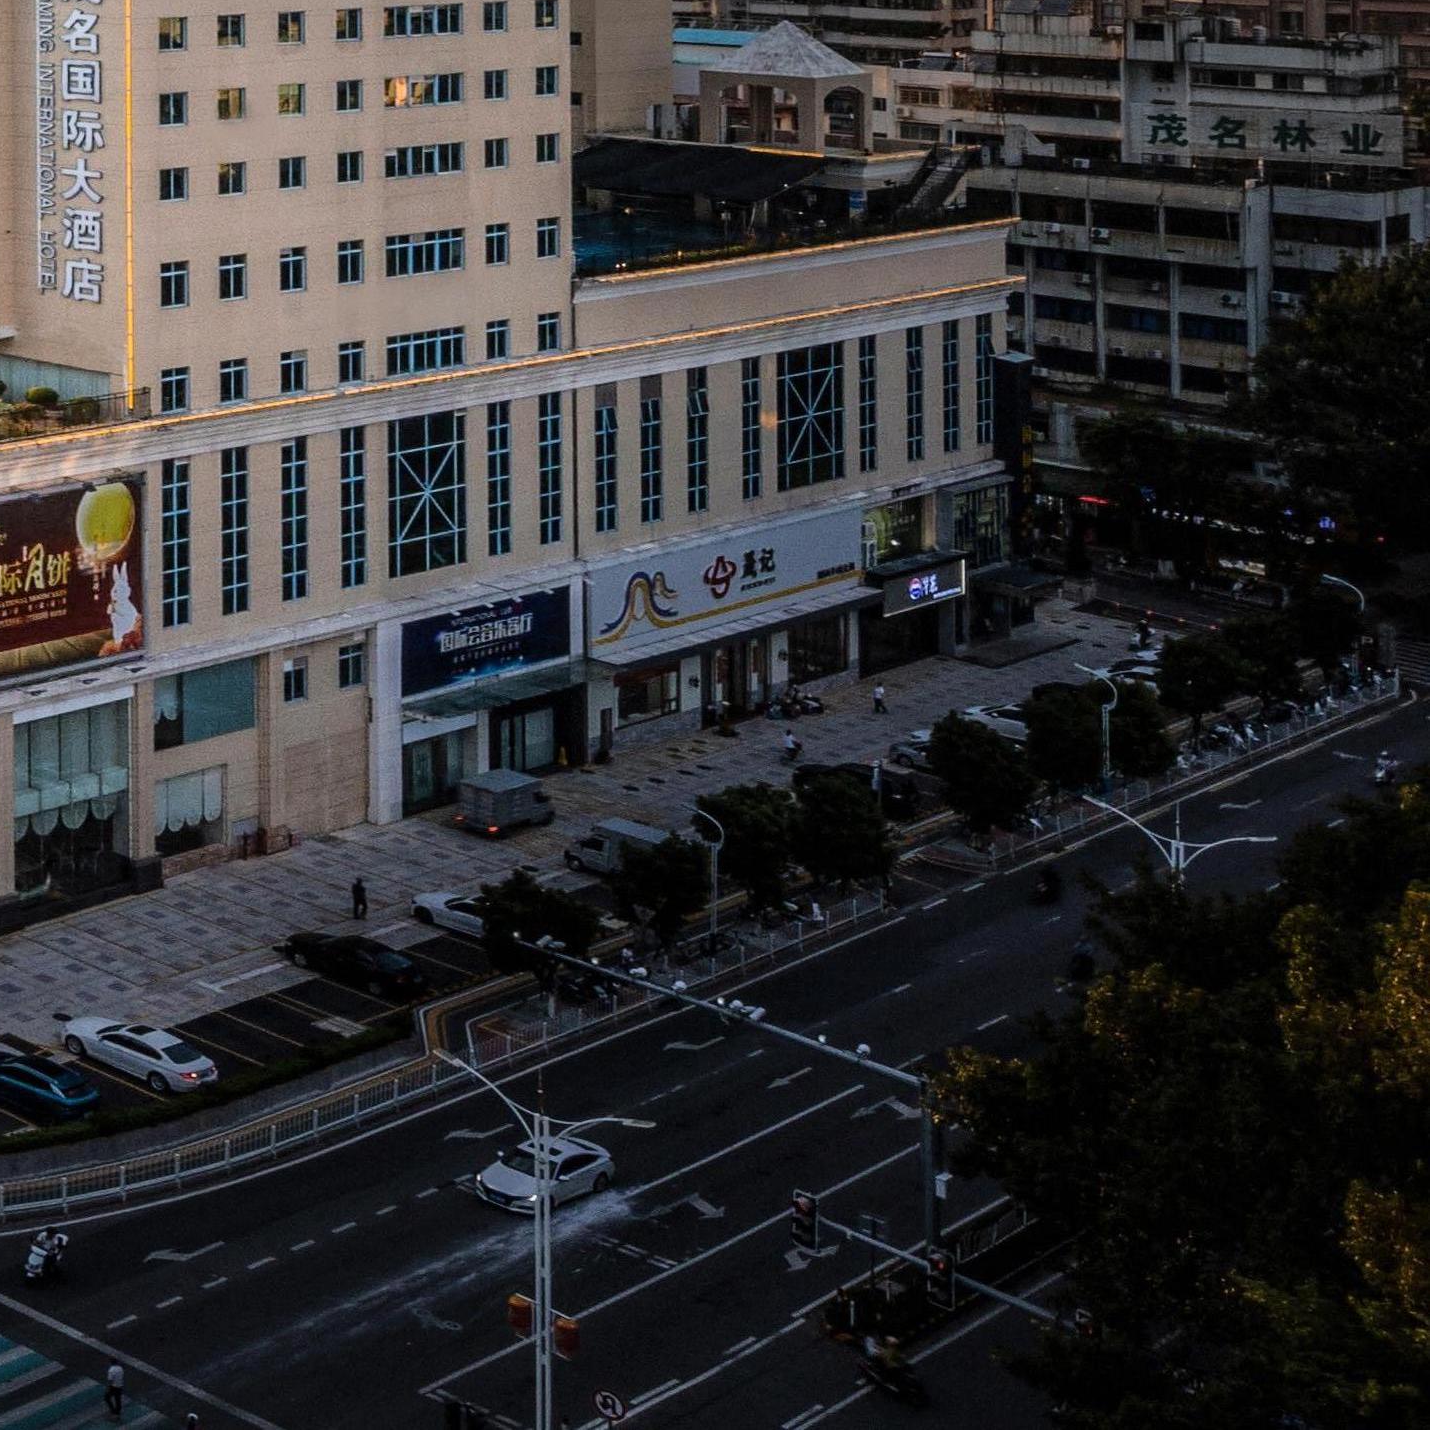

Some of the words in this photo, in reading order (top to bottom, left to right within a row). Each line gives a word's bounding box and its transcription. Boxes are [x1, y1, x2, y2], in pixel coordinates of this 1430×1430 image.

[38, 63, 57, 218] INTERNATIONAL
[1147, 113, 1385, 157] 茂名林业
[39, 231, 57, 293] HOTEL
